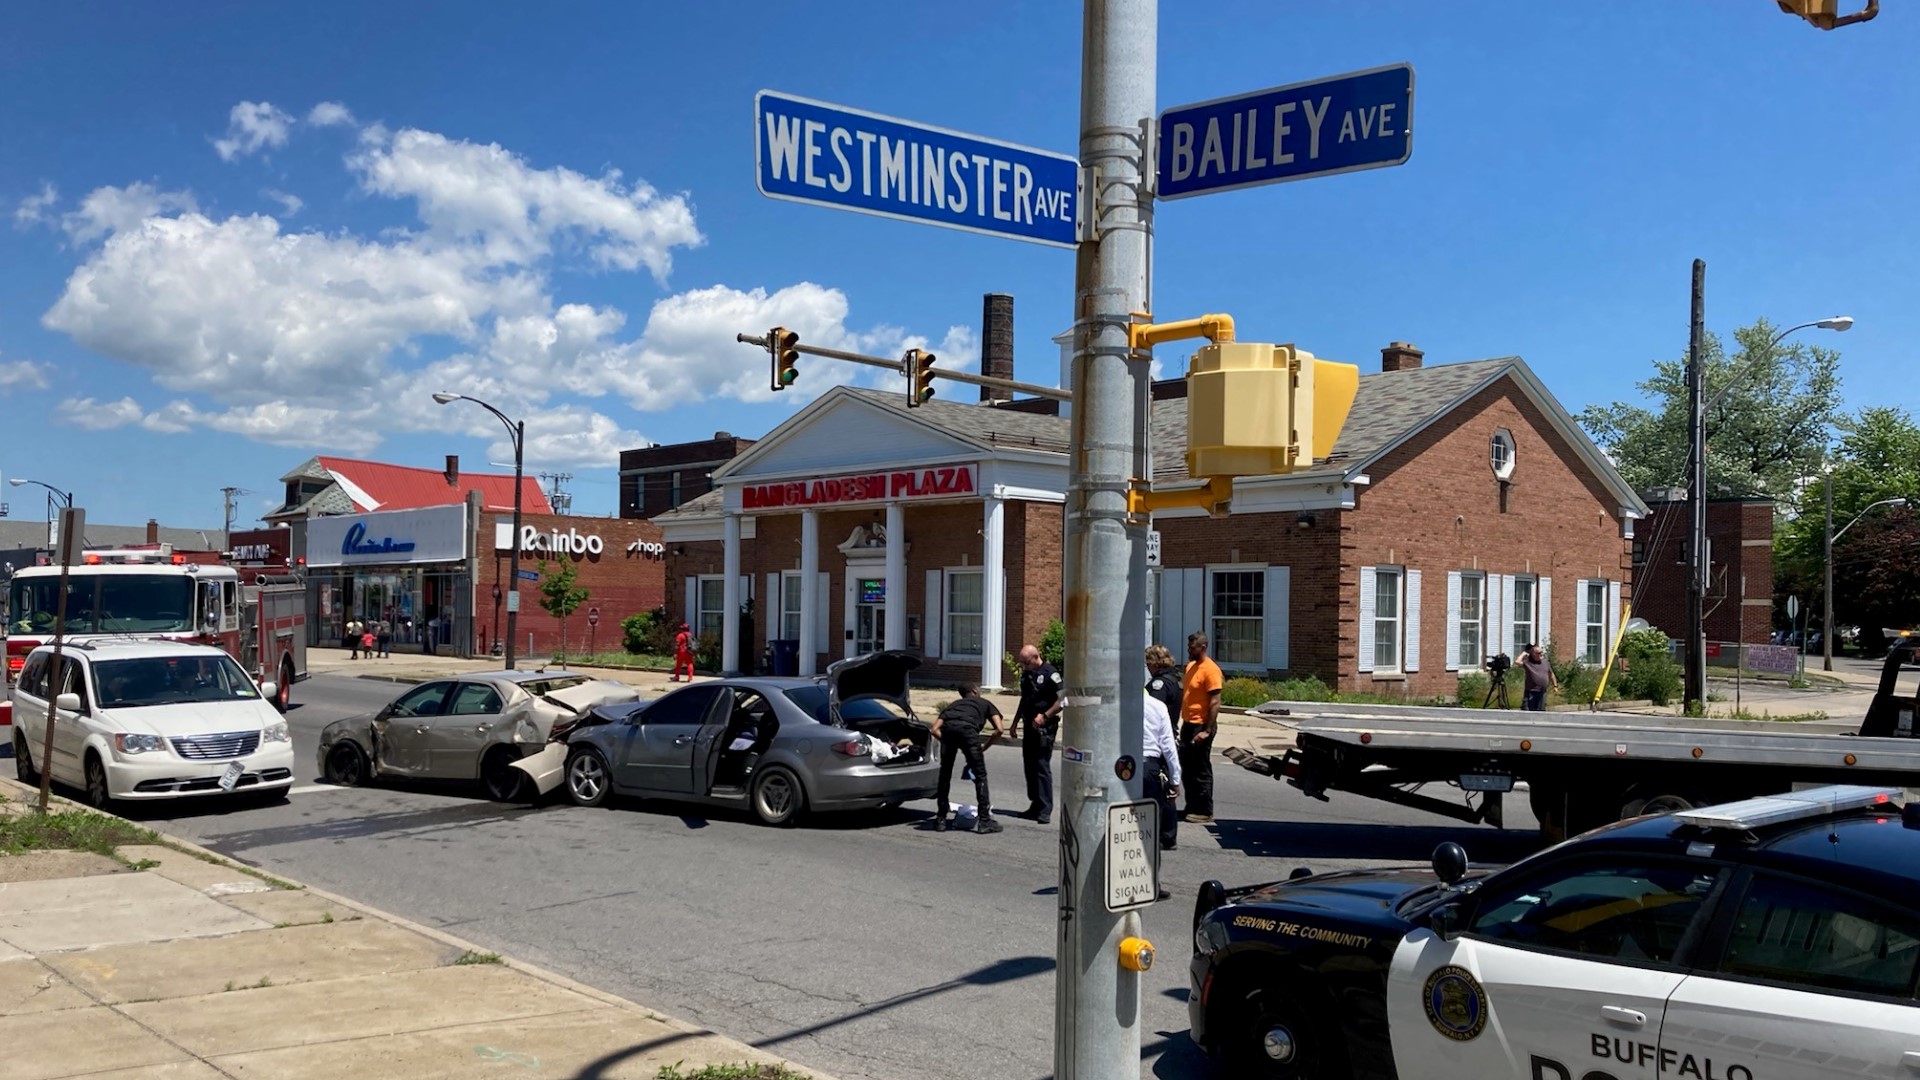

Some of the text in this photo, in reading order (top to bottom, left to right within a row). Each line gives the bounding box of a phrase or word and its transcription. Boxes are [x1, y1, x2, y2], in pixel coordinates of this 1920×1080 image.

[1170, 96, 1396, 183] BAILEY AVE
[766, 111, 1073, 225] WESTMINSTER AVE
[742, 467, 974, 509] BANGLADESH PLAZA
[520, 524, 604, 555] Rainbo
[1120, 812, 1146, 824] PUSH
[1113, 832, 1152, 844] BUTTON
[1123, 849, 1142, 861] FOR
[1119, 865, 1147, 879] WALK
[1115, 883, 1150, 899] SIGNAL
[1232, 915, 1372, 949] SERVING THE COMMUNITY
[1591, 1034, 1753, 1080] BUFFALO
